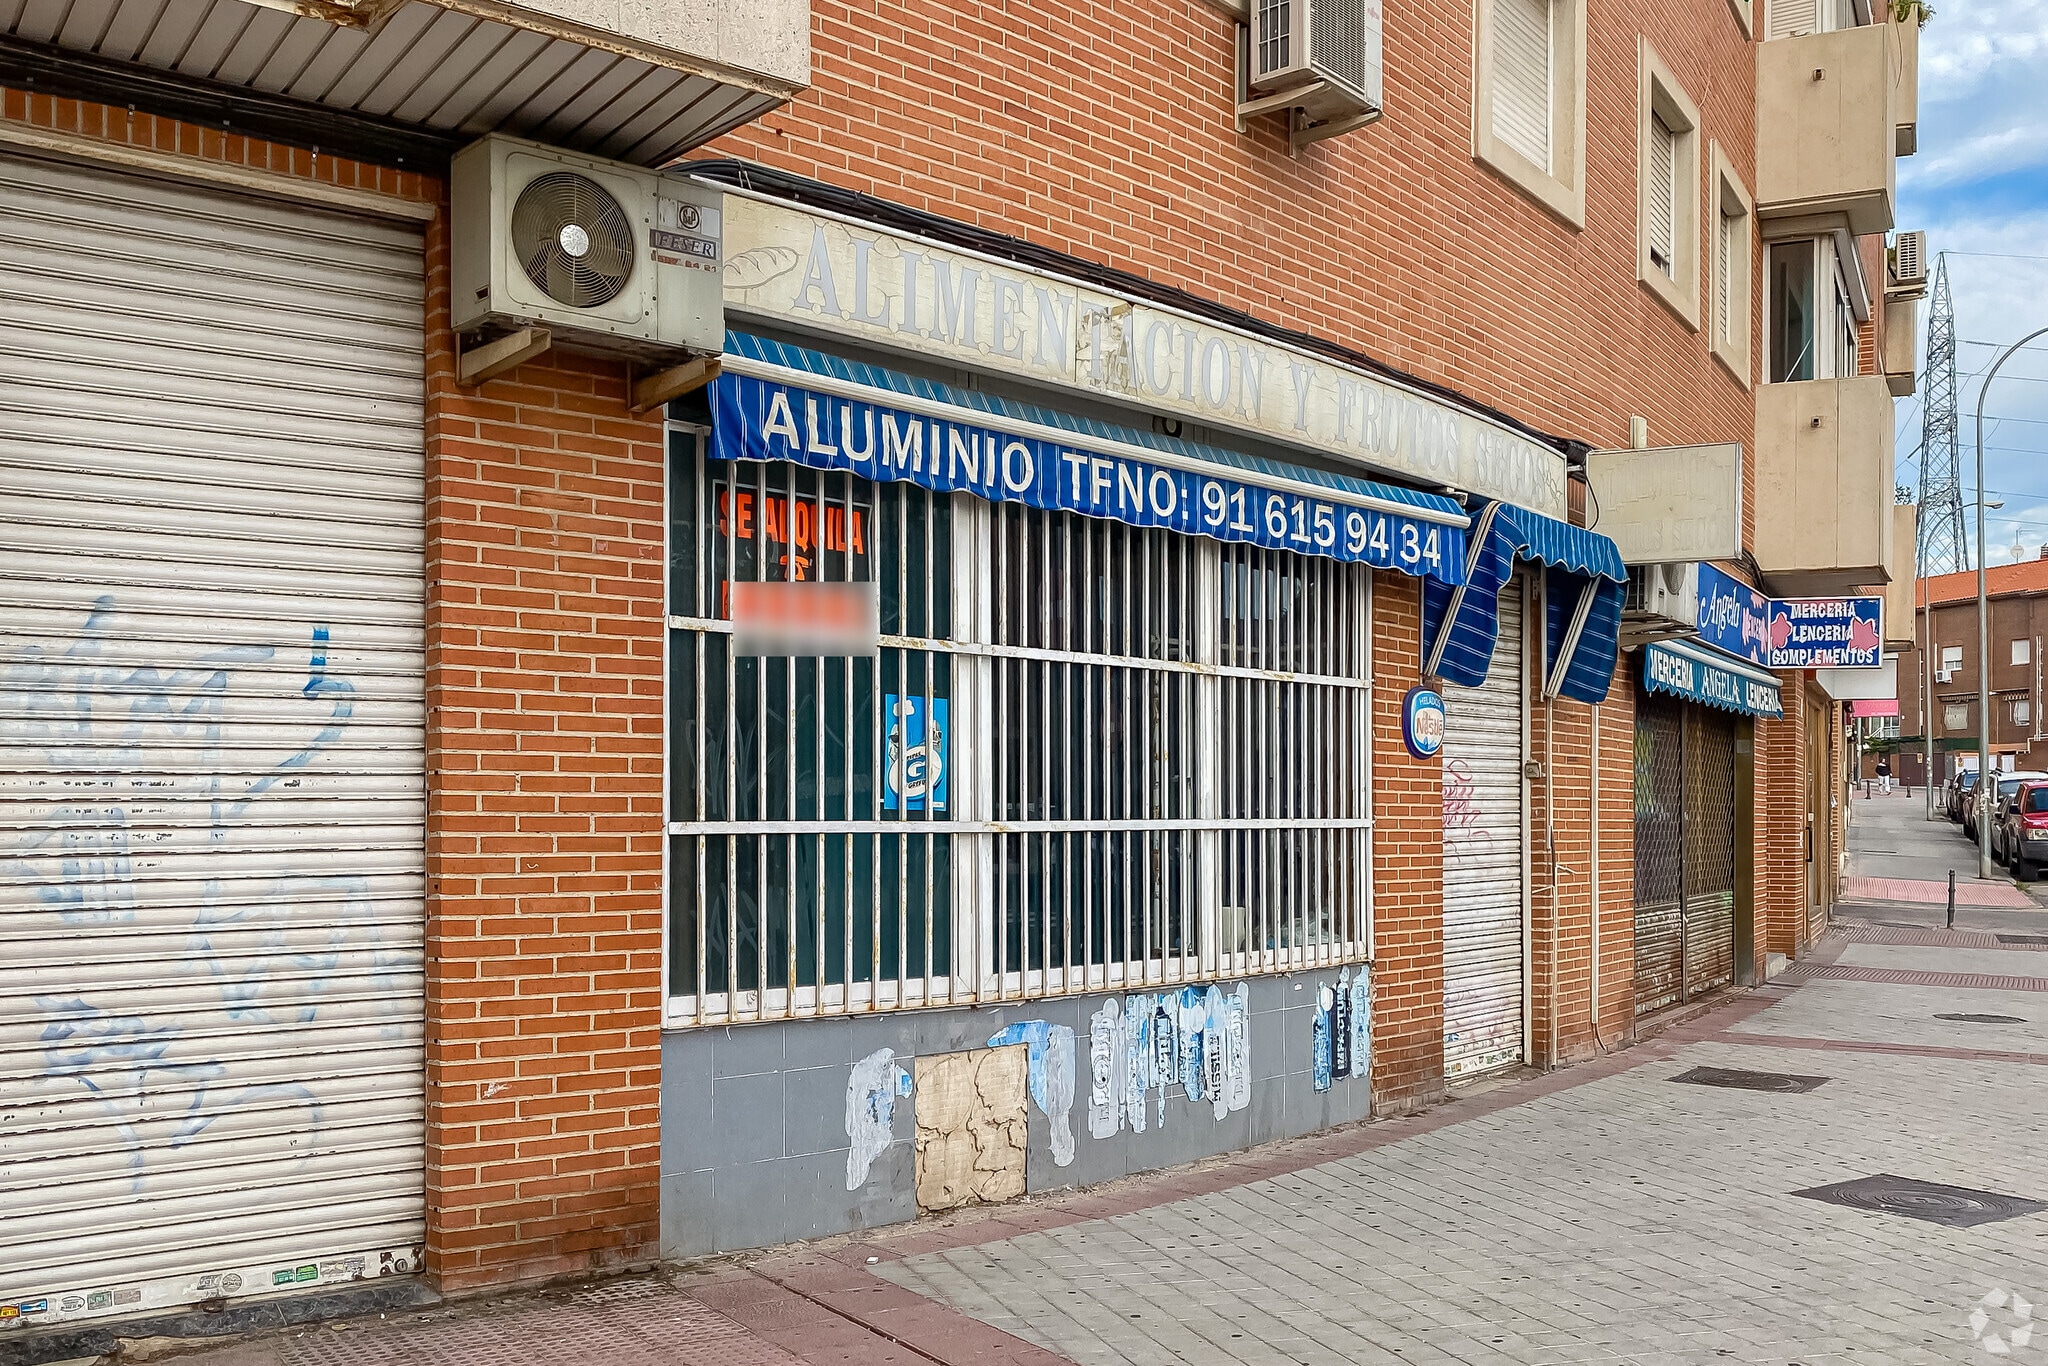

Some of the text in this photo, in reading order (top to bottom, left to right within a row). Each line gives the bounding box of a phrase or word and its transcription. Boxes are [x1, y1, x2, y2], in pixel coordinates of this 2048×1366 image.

[1289, 360, 1316, 432] Y
[1335, 374, 1460, 476] FRUTOS
[1475, 426, 1547, 508] SECOS
[762, 391, 1442, 569] ALUMINIO TFNO: 91 615 94 34
[720, 490, 864, 555] SE ALQUILA
[1790, 602, 1856, 619] MERCERIA
[1792, 624, 1853, 643] LENCERIA
[1649, 648, 1783, 713] MERCERIA ANGELA LENCERIA
[1771, 648, 1874, 667] COMPLEMENTOS
